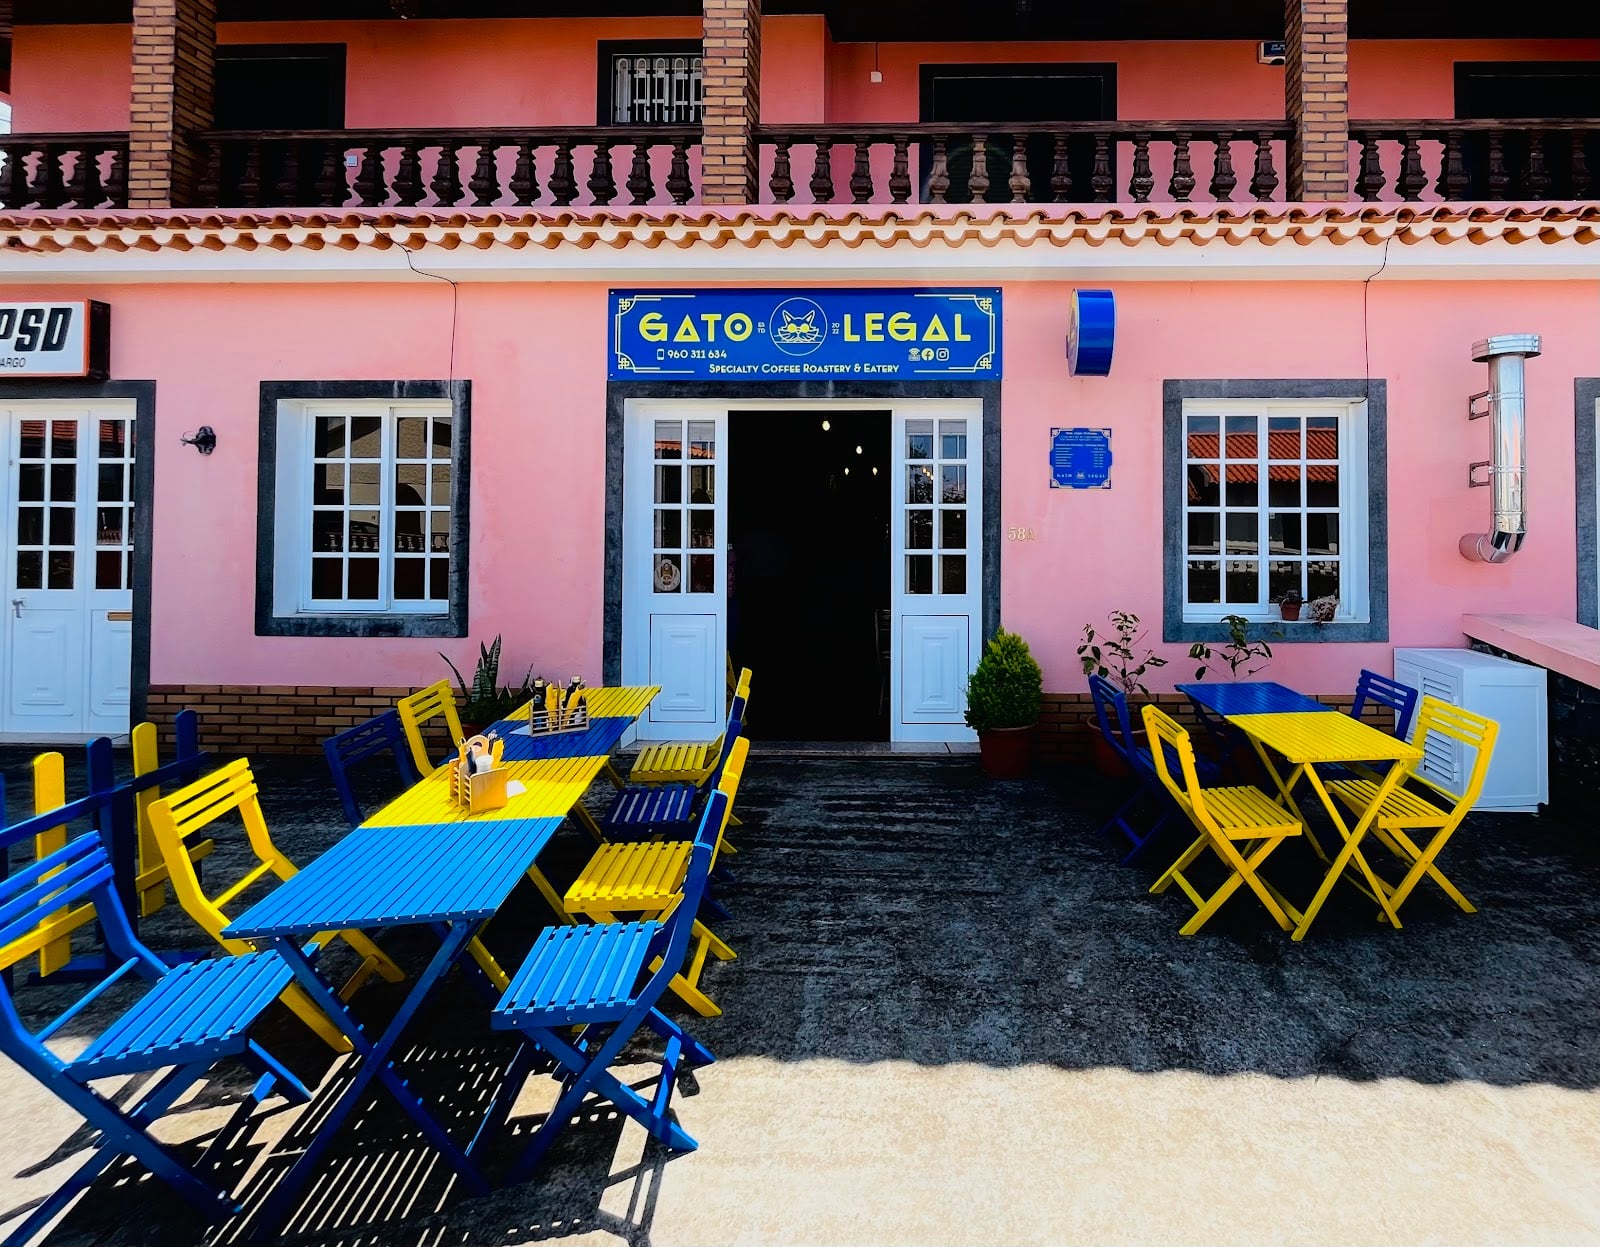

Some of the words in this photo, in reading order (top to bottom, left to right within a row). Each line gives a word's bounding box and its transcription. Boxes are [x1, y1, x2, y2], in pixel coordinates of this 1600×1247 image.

[639, 312, 753, 342] GATO
[843, 312, 972, 342] LEGAL
[667, 349, 689, 359] 960
[690, 349, 706, 359] 311
[708, 349, 727, 359] 634
[853, 364, 862, 373] &
